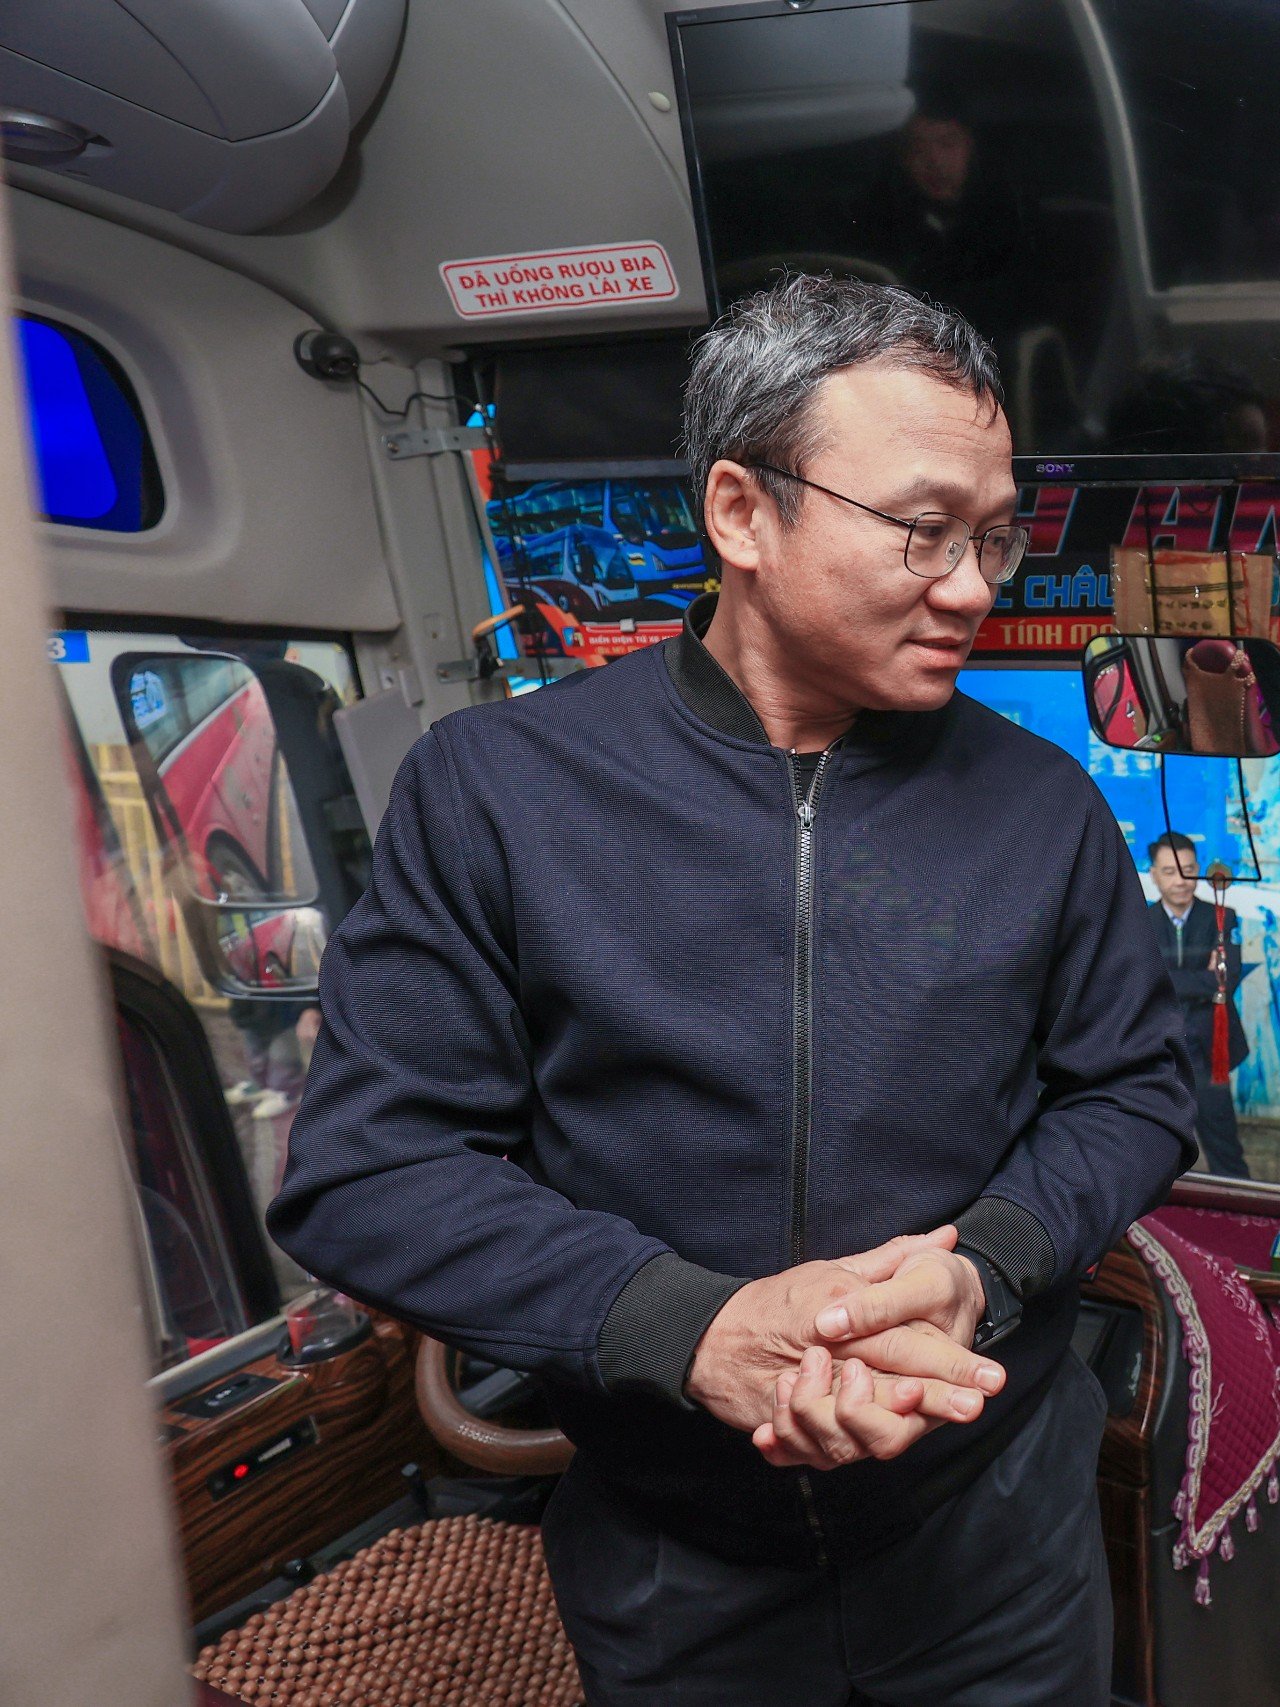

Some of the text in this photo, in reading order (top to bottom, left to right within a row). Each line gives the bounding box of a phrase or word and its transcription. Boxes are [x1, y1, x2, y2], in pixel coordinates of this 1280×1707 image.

[458, 256, 656, 290] ĐÃ UỐNG RƯỢU BIA
[475, 276, 654, 308] THÌ KHÔNG LÁI XE
[1035, 463, 1075, 473] SONY
[999, 620, 1058, 645] TÍNH
